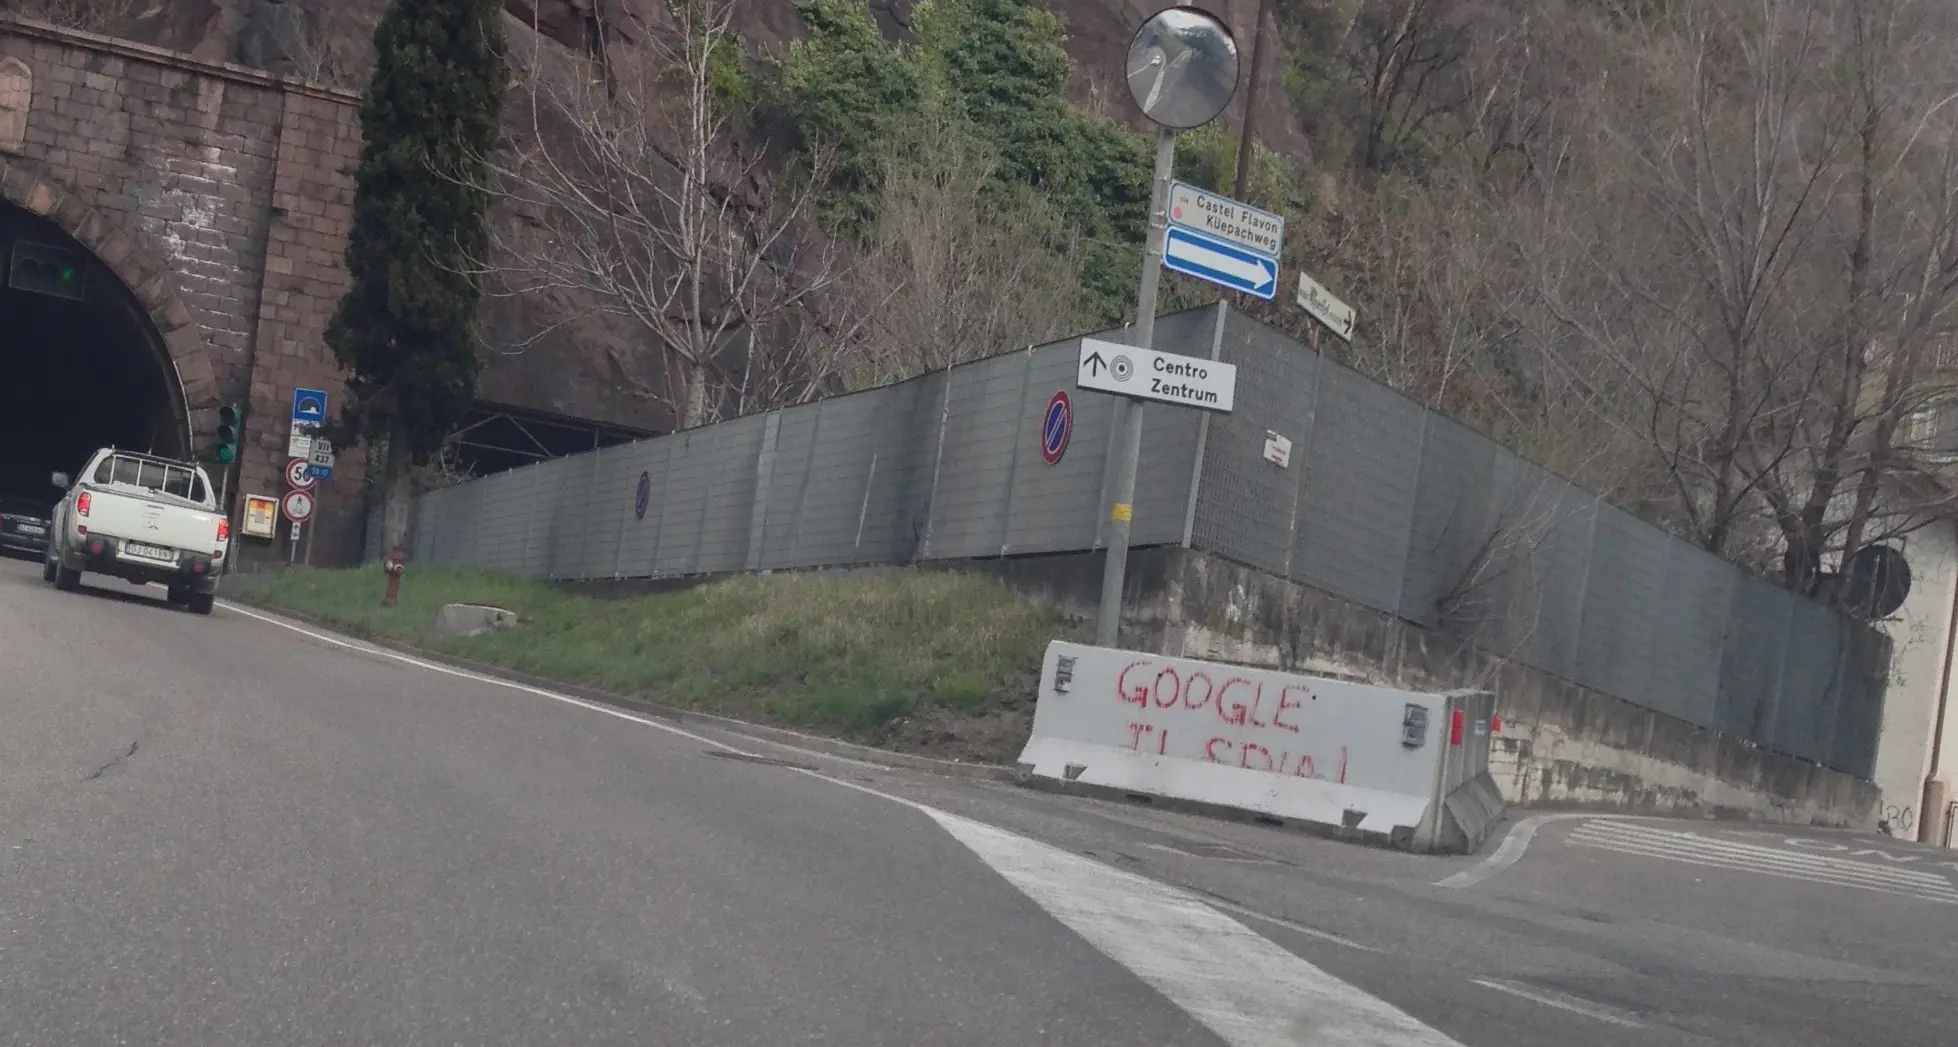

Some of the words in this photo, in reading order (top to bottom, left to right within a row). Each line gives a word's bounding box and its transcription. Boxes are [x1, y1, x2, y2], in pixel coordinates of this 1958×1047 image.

[1197, 195, 1234, 219] Castel
[1241, 211, 1278, 234] Flavon
[1153, 356, 1208, 379] Centro
[1151, 378, 1218, 403] Zentrum
[314, 454, 330, 464] 437
[1116, 660, 1310, 733] GOOGLE
